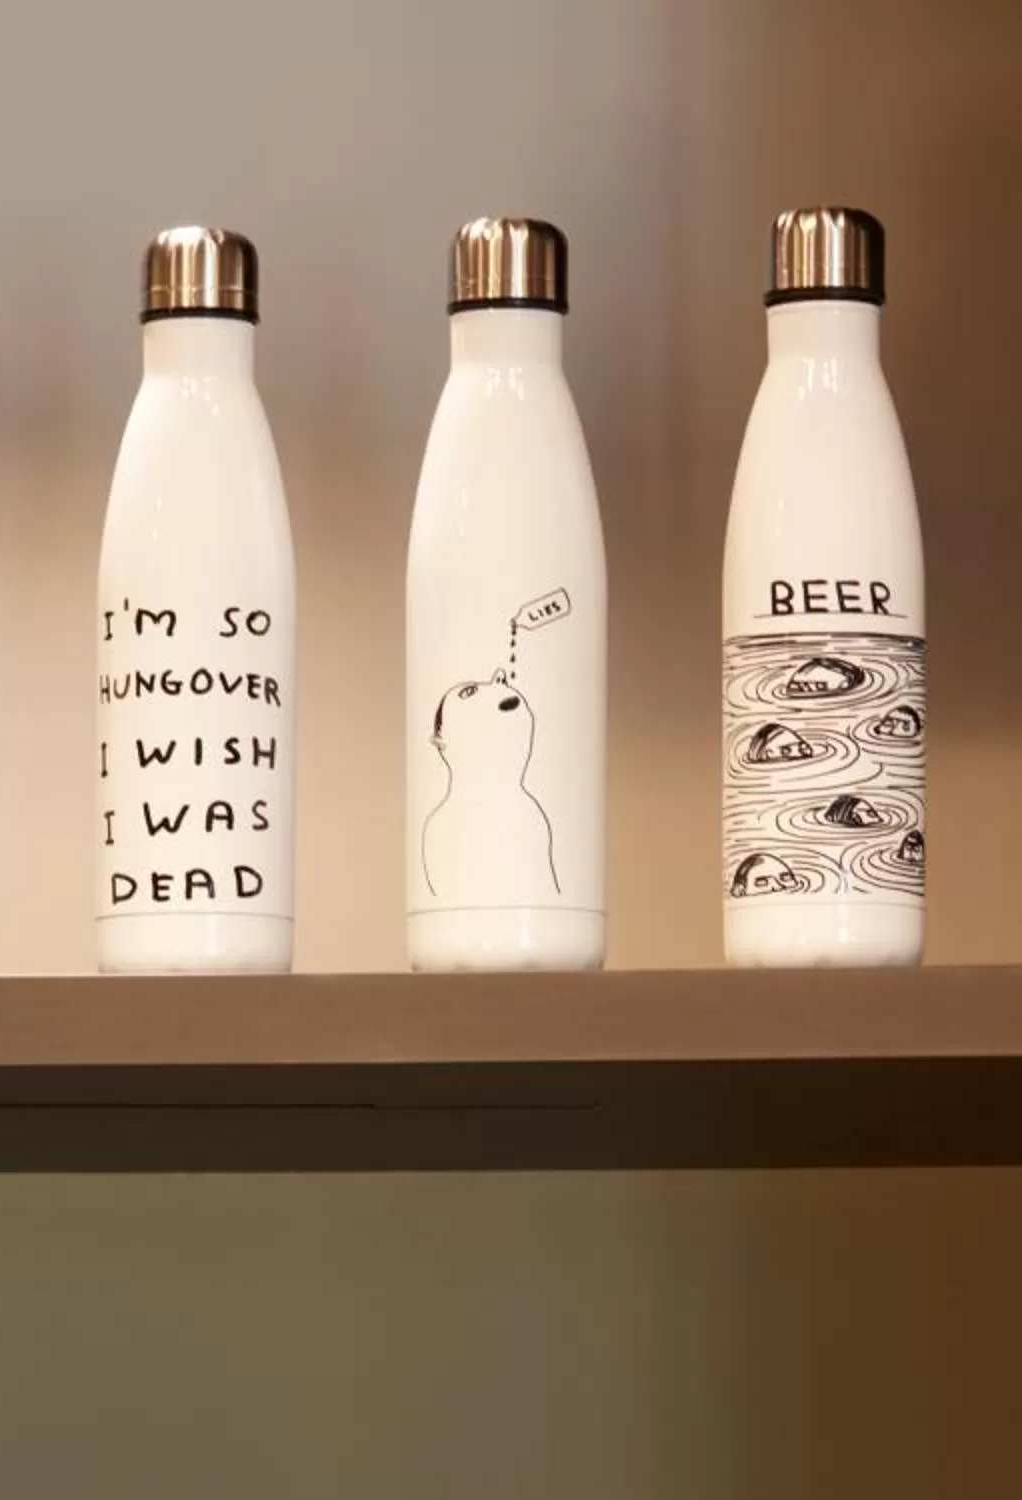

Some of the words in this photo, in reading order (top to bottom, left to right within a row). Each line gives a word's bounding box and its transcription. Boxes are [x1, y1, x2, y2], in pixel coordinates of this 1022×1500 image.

[771, 579, 891, 616] BEER
[103, 598, 177, 641] I'M
[220, 606, 271, 638] SO
[99, 667, 281, 708] HUNGOVER
[101, 741, 109, 778] I
[136, 737, 276, 770] WISH
[104, 810, 115, 845] I
[143, 800, 269, 836] WAS
[111, 865, 263, 905] DEAD
